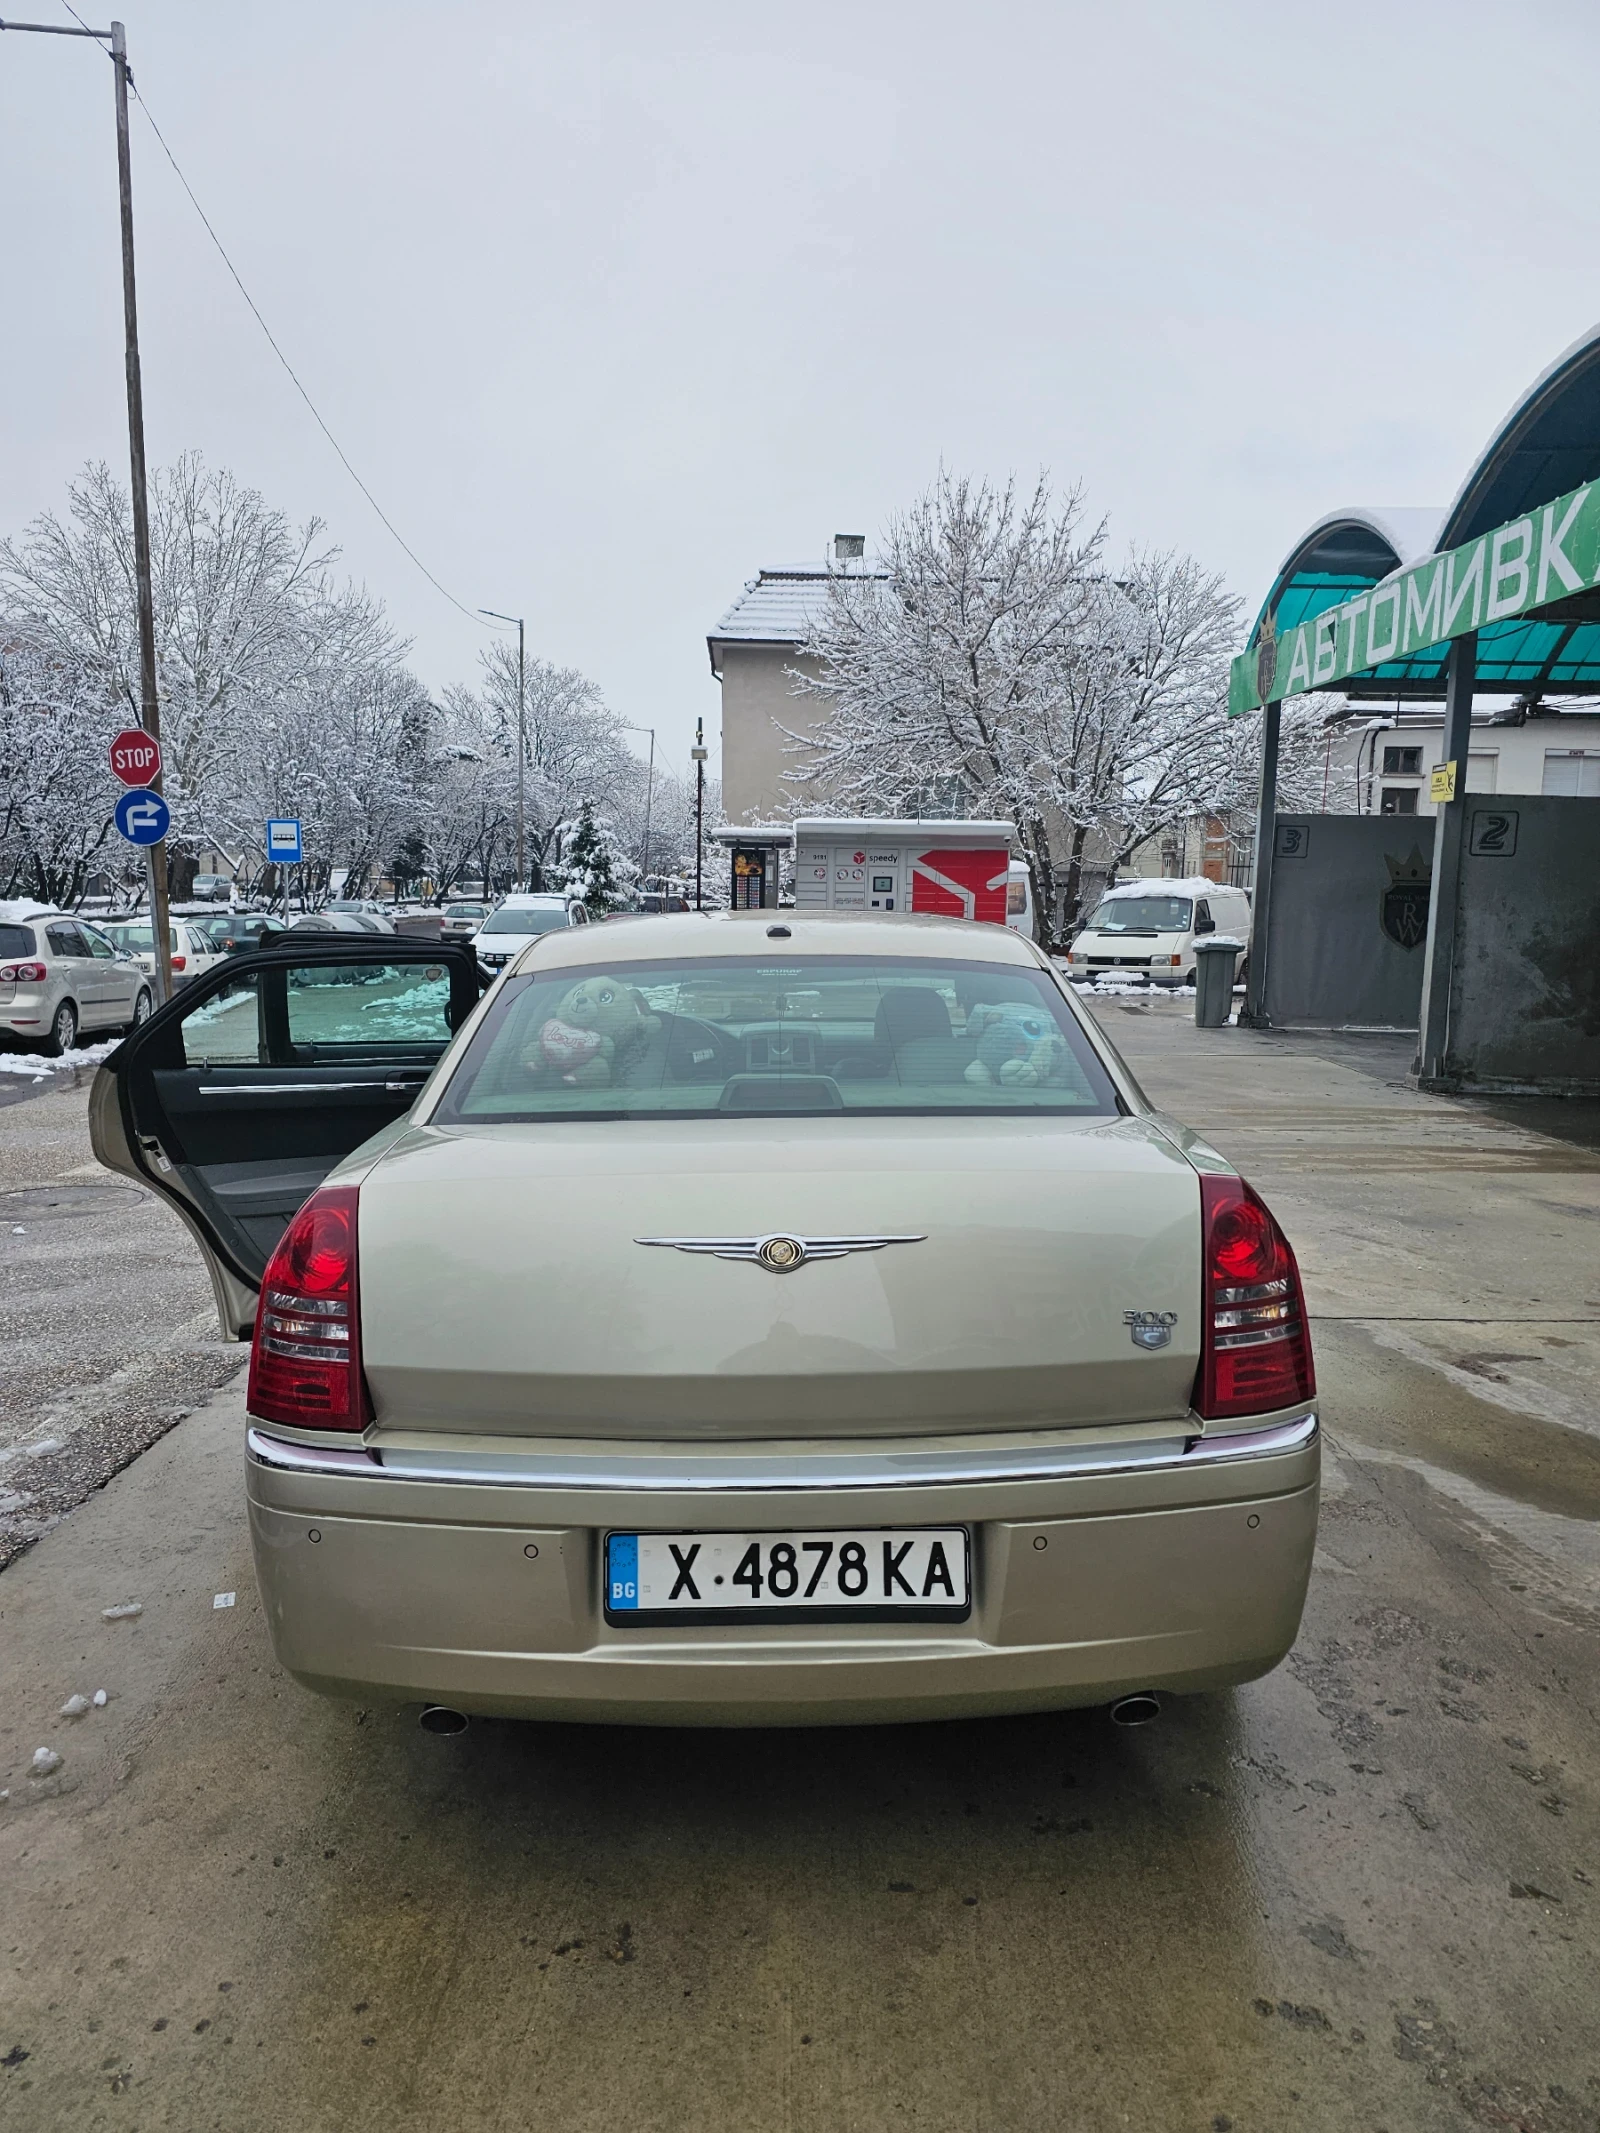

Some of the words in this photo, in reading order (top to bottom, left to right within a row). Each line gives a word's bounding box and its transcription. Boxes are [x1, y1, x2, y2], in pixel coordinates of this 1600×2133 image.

[1285, 487, 1600, 694] АВТОМИВК
[115, 747, 154, 769] STOP
[1282, 829, 1302, 853] 3
[1478, 816, 1509, 850] 2
[869, 854, 898, 863] speedy
[1122, 1309, 1178, 1325] 300
[612, 1582, 635, 1599] BG
